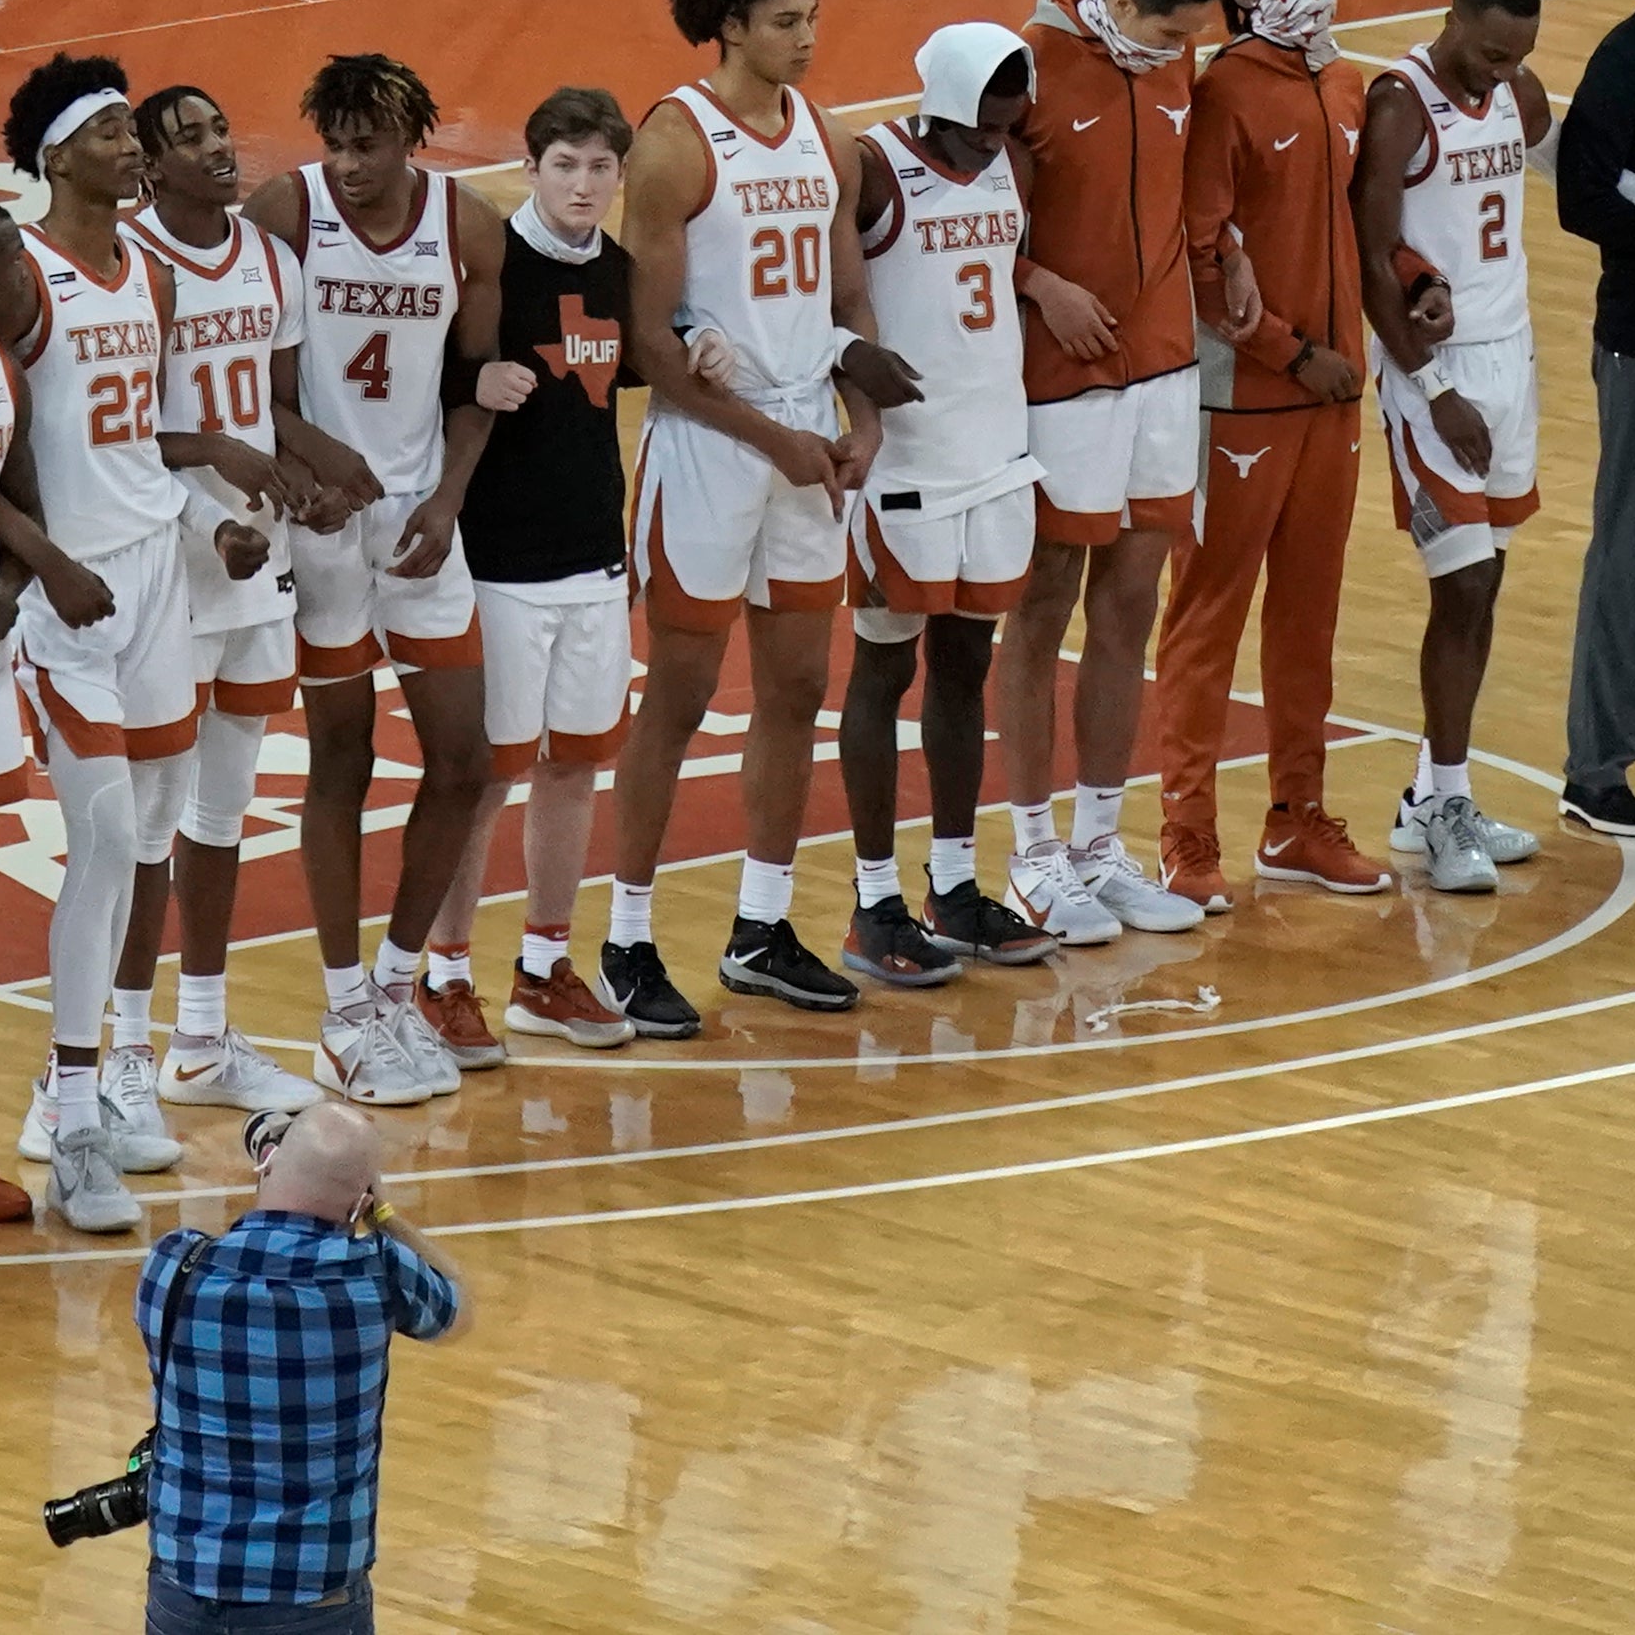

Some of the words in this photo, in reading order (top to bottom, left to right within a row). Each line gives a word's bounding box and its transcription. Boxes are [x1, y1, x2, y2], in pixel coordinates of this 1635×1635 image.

[731, 175, 831, 217] TEXAS
[1444, 138, 1522, 186] TEXAS
[750, 223, 821, 301] 20
[914, 210, 1021, 254] TEXAS
[1479, 190, 1509, 264] 2
[171, 303, 275, 356] TEXAS
[315, 276, 444, 320] TEXAS
[956, 259, 996, 334] 3
[189, 354, 261, 432] 10
[343, 330, 393, 403] 4
[87, 366, 155, 449] 22
